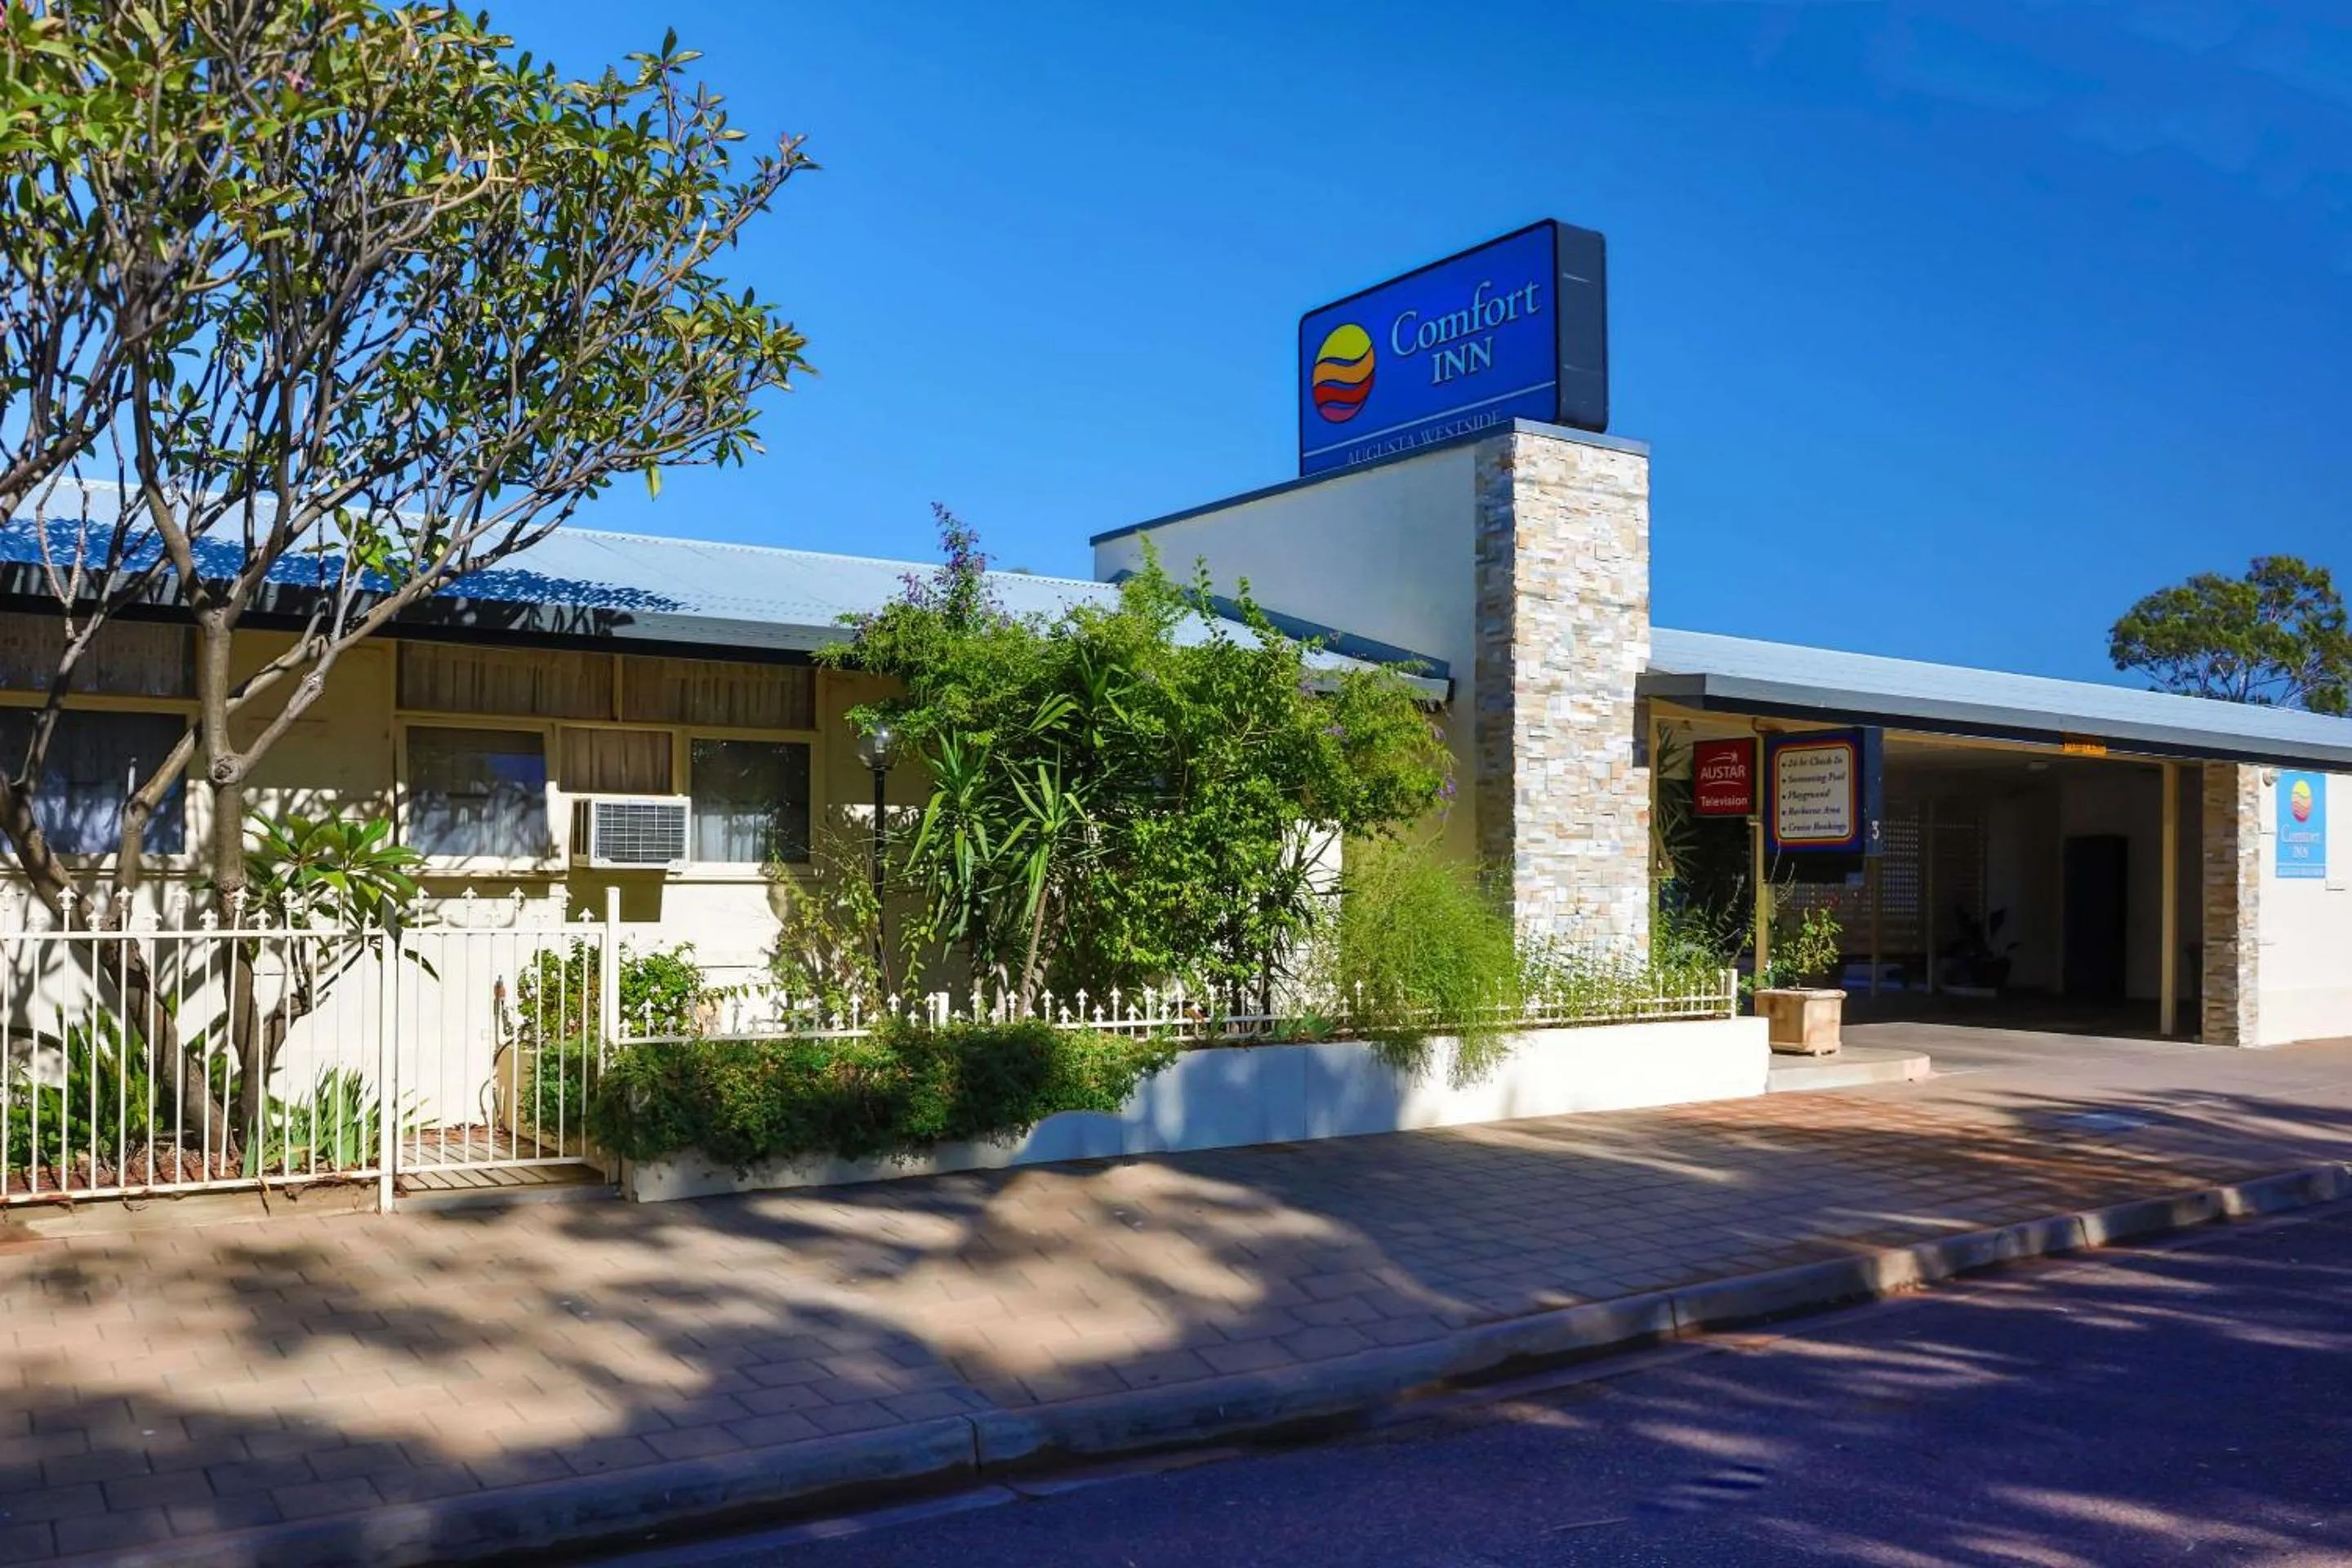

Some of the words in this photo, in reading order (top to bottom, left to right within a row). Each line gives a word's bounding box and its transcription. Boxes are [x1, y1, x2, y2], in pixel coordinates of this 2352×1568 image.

[1391, 281, 1540, 357] Comfort
[1431, 336, 1493, 385] INN
[1348, 434, 1418, 466] AUGUSTA
[1419, 410, 1502, 446] WESTSIDE
[1810, 755, 1833, 766] Check
[1700, 764, 1746, 780] AUSTAR
[1828, 770, 1846, 782] Pool
[1701, 795, 1748, 808] Television
[1788, 787, 1831, 802] Playground
